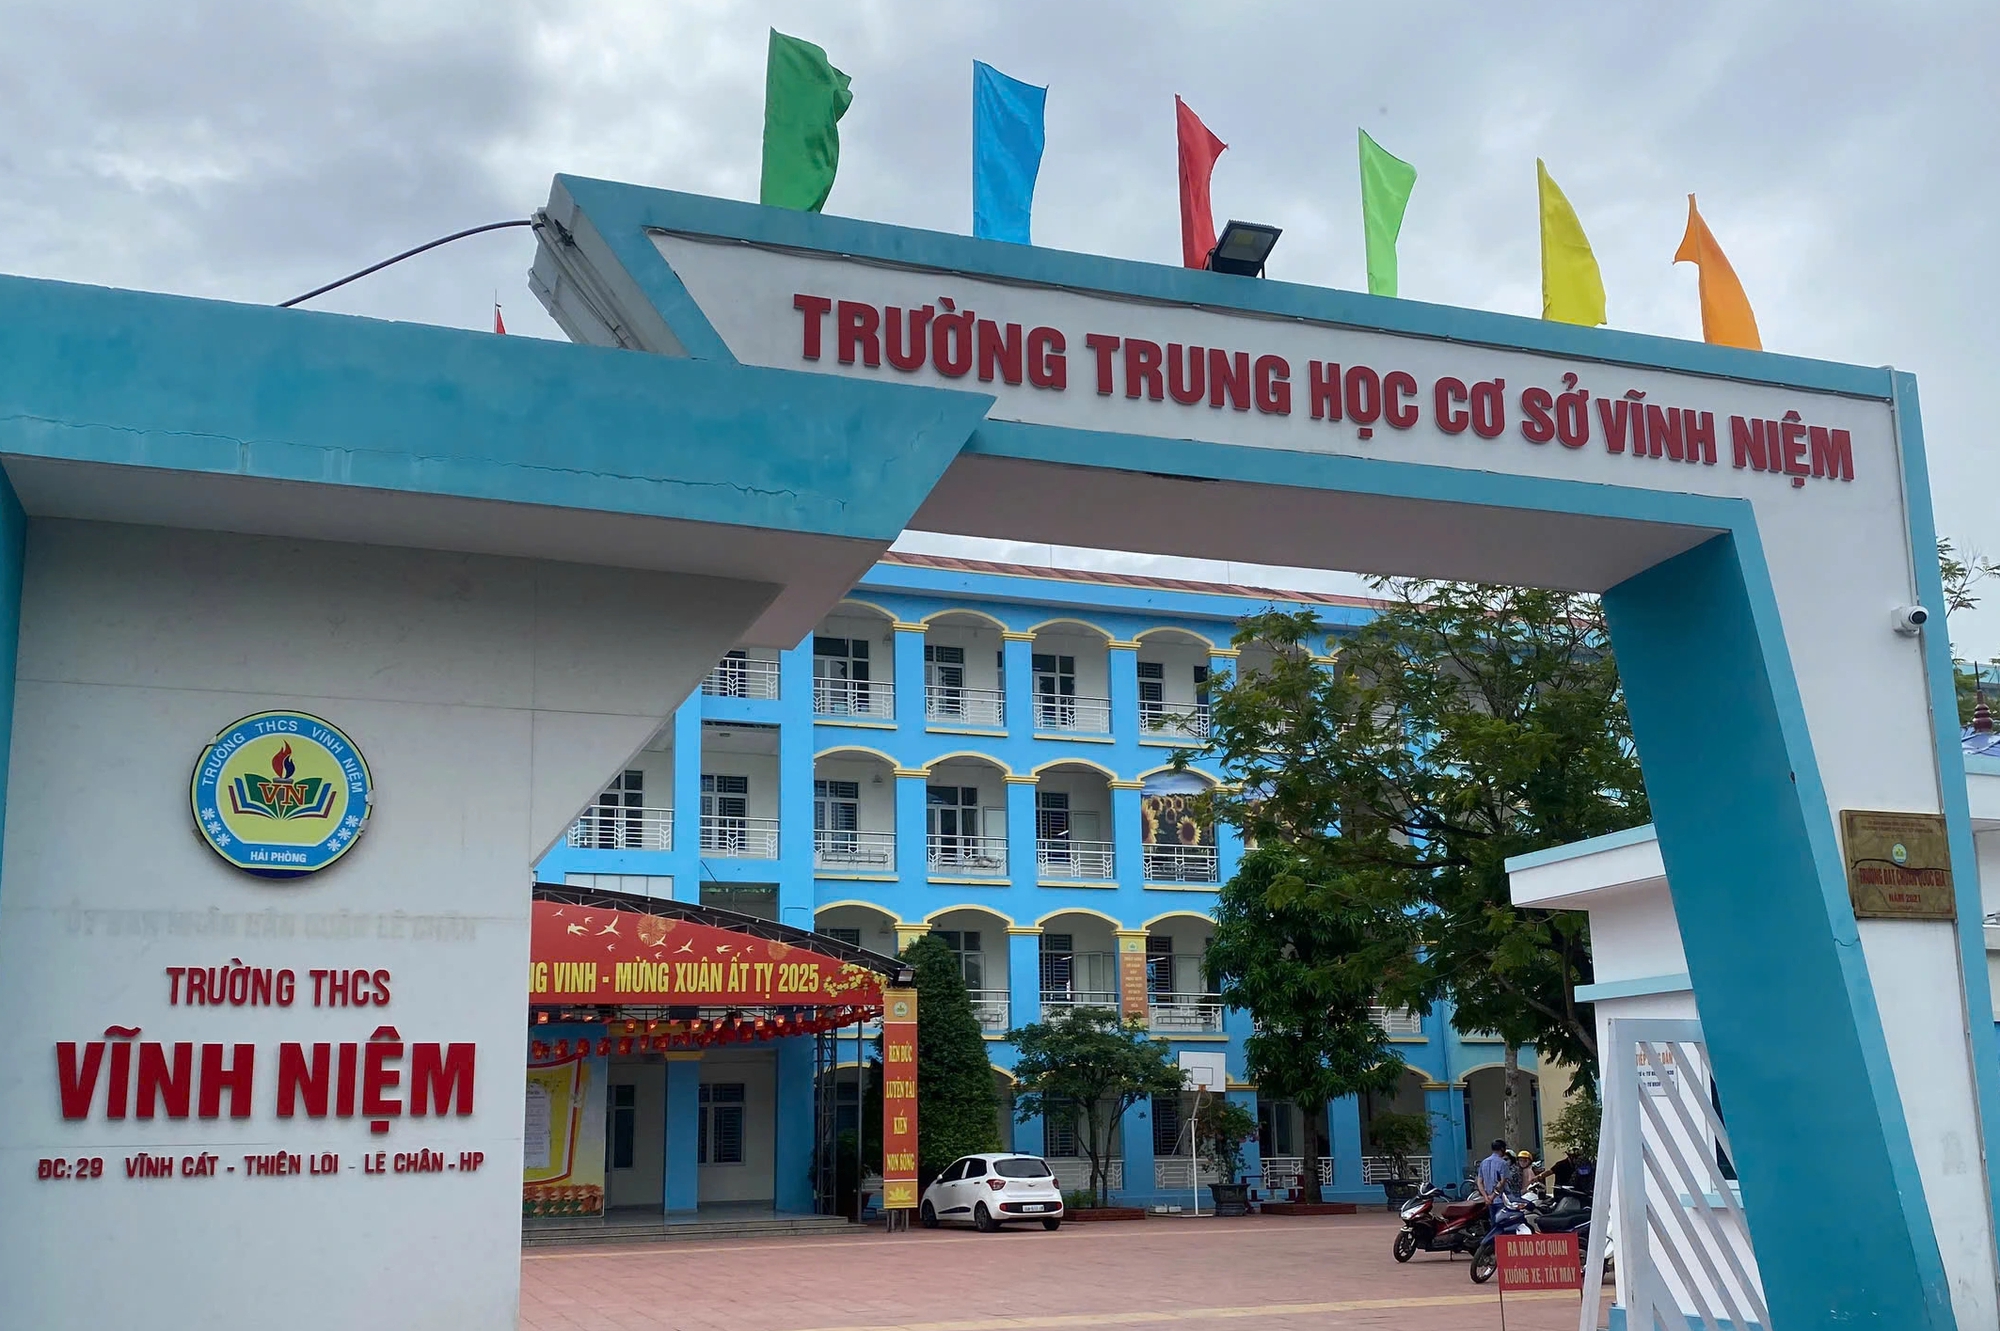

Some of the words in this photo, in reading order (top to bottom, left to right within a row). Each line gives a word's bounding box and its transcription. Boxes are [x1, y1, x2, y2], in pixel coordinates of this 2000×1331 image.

[793, 293, 1067, 391] TRƯỜNG
[1085, 332, 1292, 416] TRUNG
[1308, 359, 1419, 440] HỌC
[1433, 375, 1506, 439] CƠ
[1520, 371, 1590, 449] SỞ
[1596, 389, 1718, 466] VĨNH
[1730, 409, 1855, 489] NIỆM
[201, 732, 246, 787] TRƯỜNG
[255, 719, 299, 734] THCS
[312, 726, 345, 755] VĨNH
[342, 757, 364, 794] NIỆM
[258, 783, 308, 806] VN
[250, 848, 269, 861] HẢI
[271, 851, 307, 863] PHÒNG
[165, 957, 296, 1007] TRƯỜNG
[309, 968, 392, 1008] THCS
[553, 962, 597, 993] VINH
[614, 956, 670, 994] MỪNG
[674, 957, 724, 993] XUÂN
[727, 952, 749, 993] ẤT
[754, 962, 774, 999] TỴ
[777, 963, 820, 993] 2025
[55, 1024, 256, 1120] VĨNH
[276, 1025, 477, 1133] NIỆM
[125, 1152, 174, 1178] VĨNH
[181, 1151, 219, 1177] CÁT
[243, 1150, 302, 1176] THIÊN
[393, 1148, 444, 1173] CHÂN
[459, 1151, 485, 1172] HP
[1507, 1241, 1518, 1257] RA
[1519, 1238, 1534, 1257] VÀO
[1535, 1240, 1546, 1257] CƠ
[1547, 1239, 1568, 1258] QUAN
